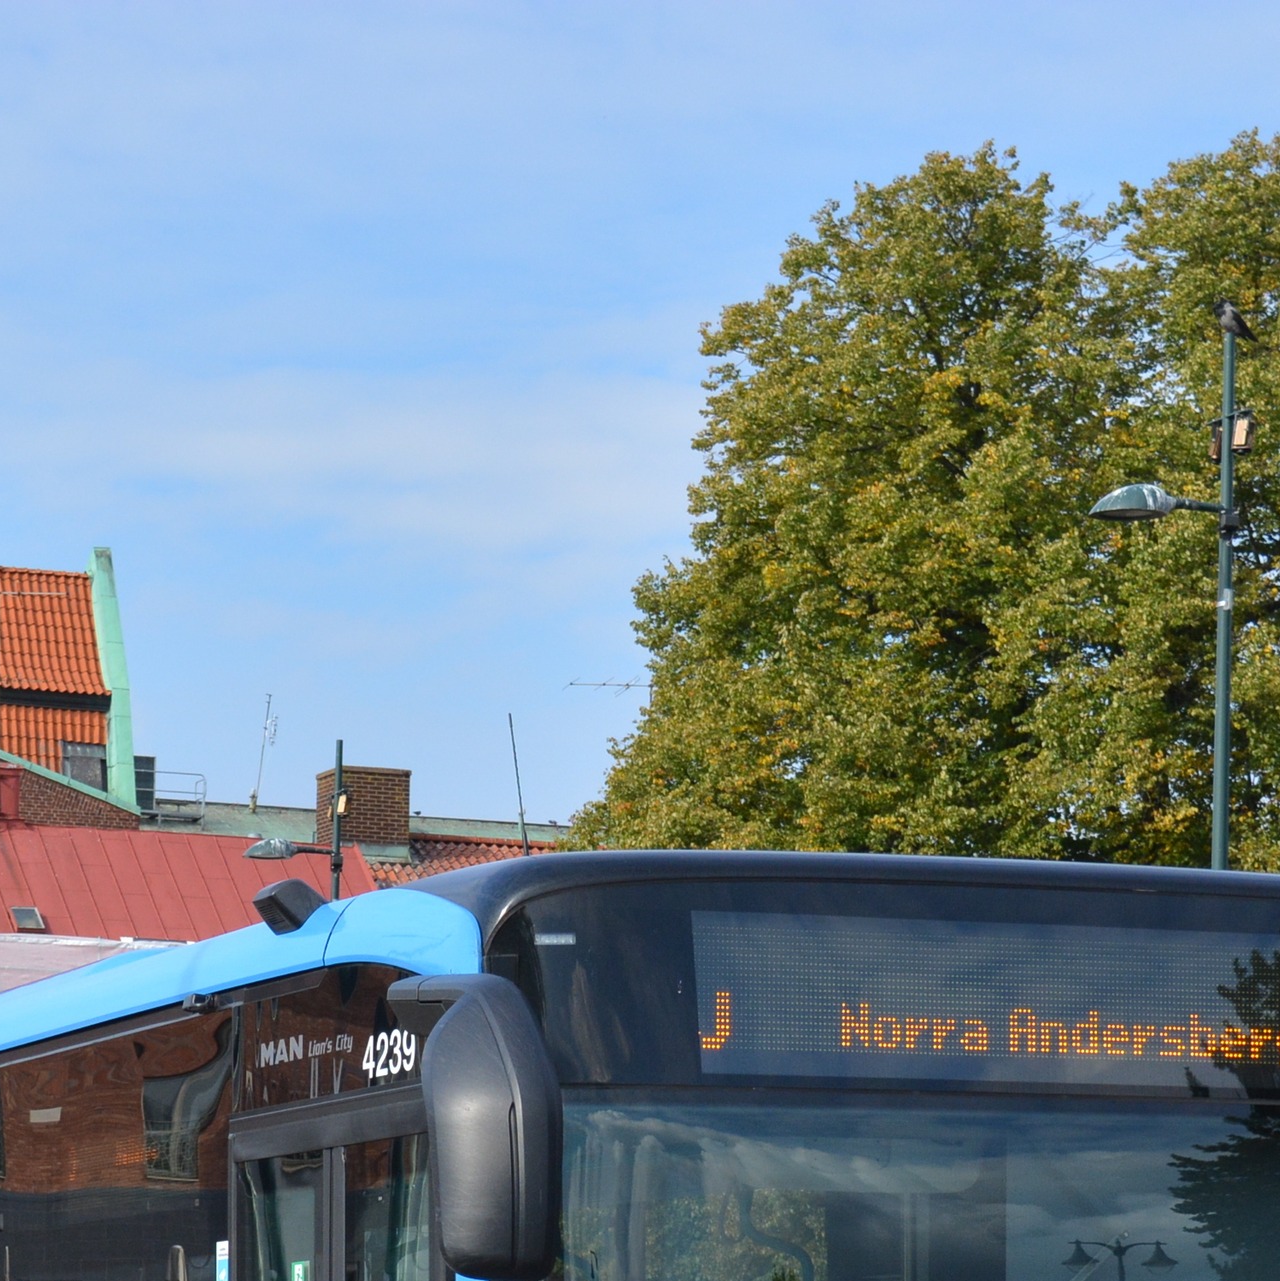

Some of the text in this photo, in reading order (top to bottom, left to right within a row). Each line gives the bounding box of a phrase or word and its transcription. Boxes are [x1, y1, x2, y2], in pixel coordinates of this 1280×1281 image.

[698, 991, 731, 1049] J
[841, 1002, 989, 1051] Norra
[260, 1033, 353, 1068] MAN Lion's City
[362, 1028, 416, 1079] 4239
